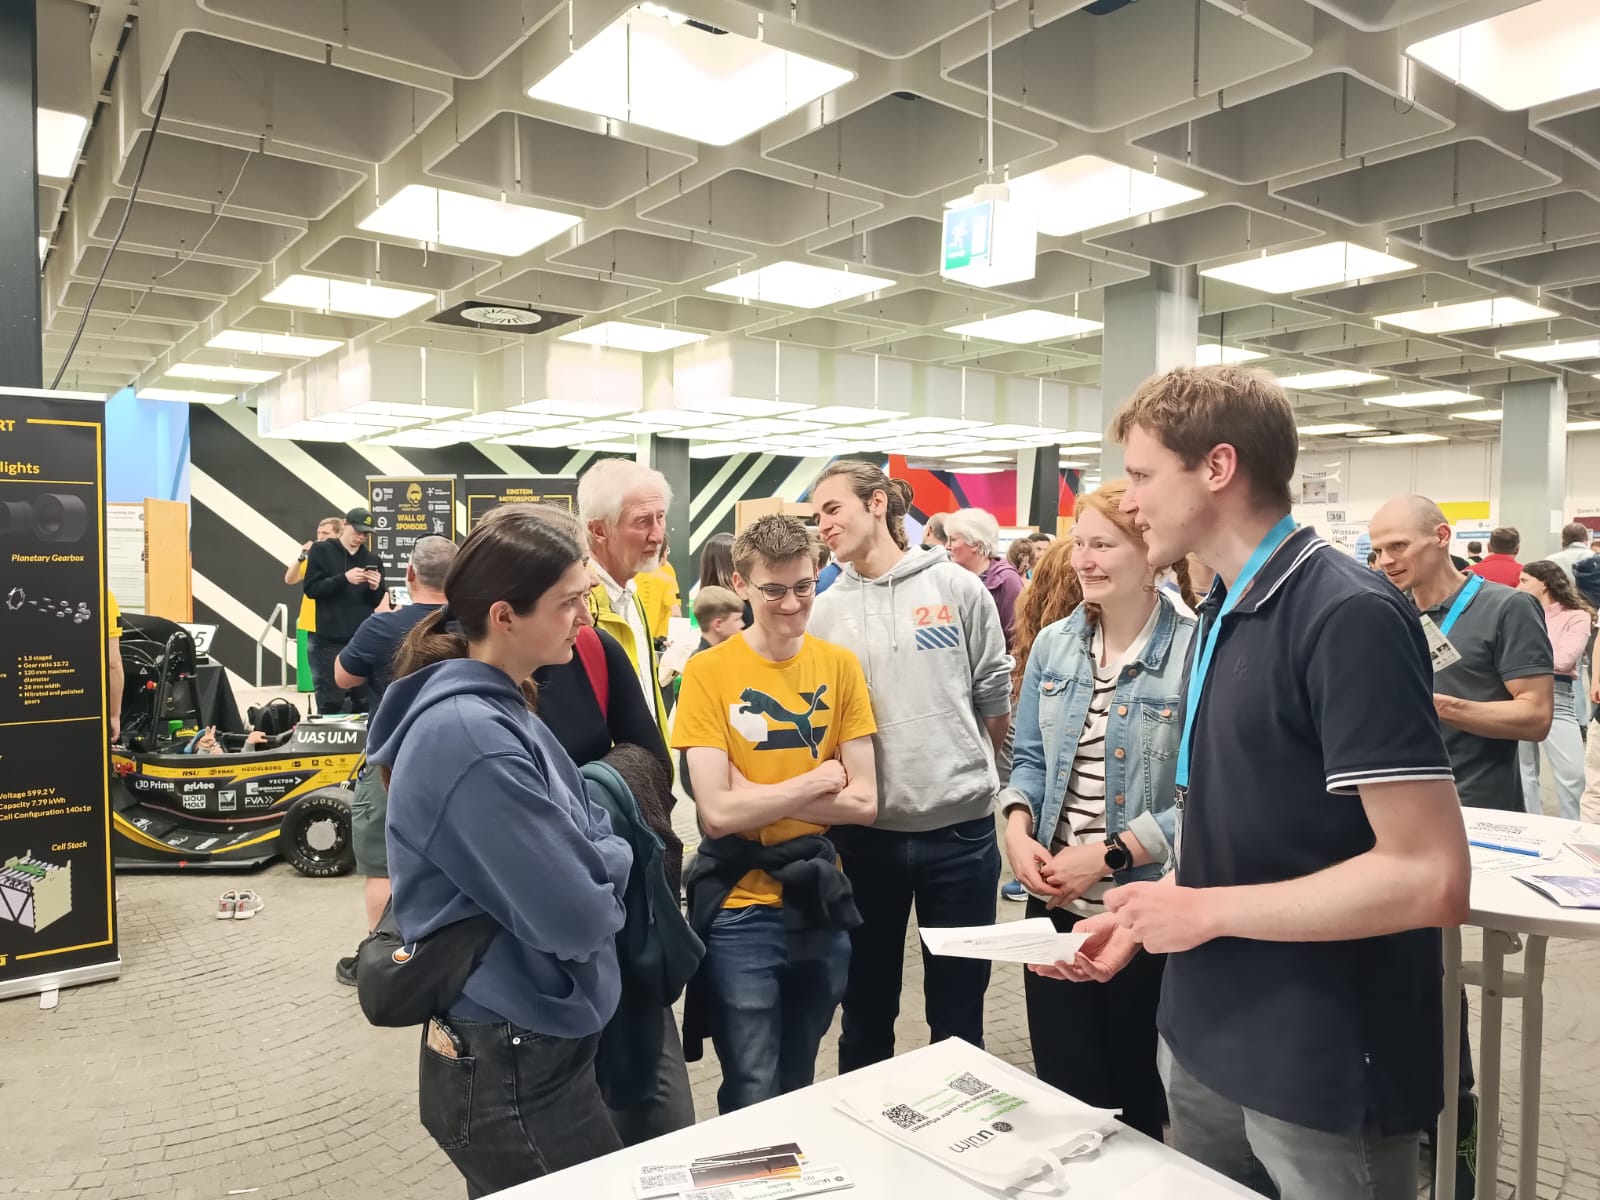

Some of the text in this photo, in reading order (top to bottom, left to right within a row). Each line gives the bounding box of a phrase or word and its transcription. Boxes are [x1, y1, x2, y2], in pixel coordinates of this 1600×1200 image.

[397, 514, 426, 522] WALL OF
[11, 554, 85, 563] Planetary Gearbox
[60, 688, 84, 696] polished
[297, 731, 358, 744] UAS ULM
[139, 780, 175, 789] 3D Prima
[27, 788, 48, 797] 599.2
[49, 787, 56, 795] V
[0, 797, 66, 811] Capacity 7.79 kWh
[244, 796, 265, 805] FVA
[0, 805, 92, 821] Cell Configuration 140s1p
[51, 840, 88, 851] Cell Stack
